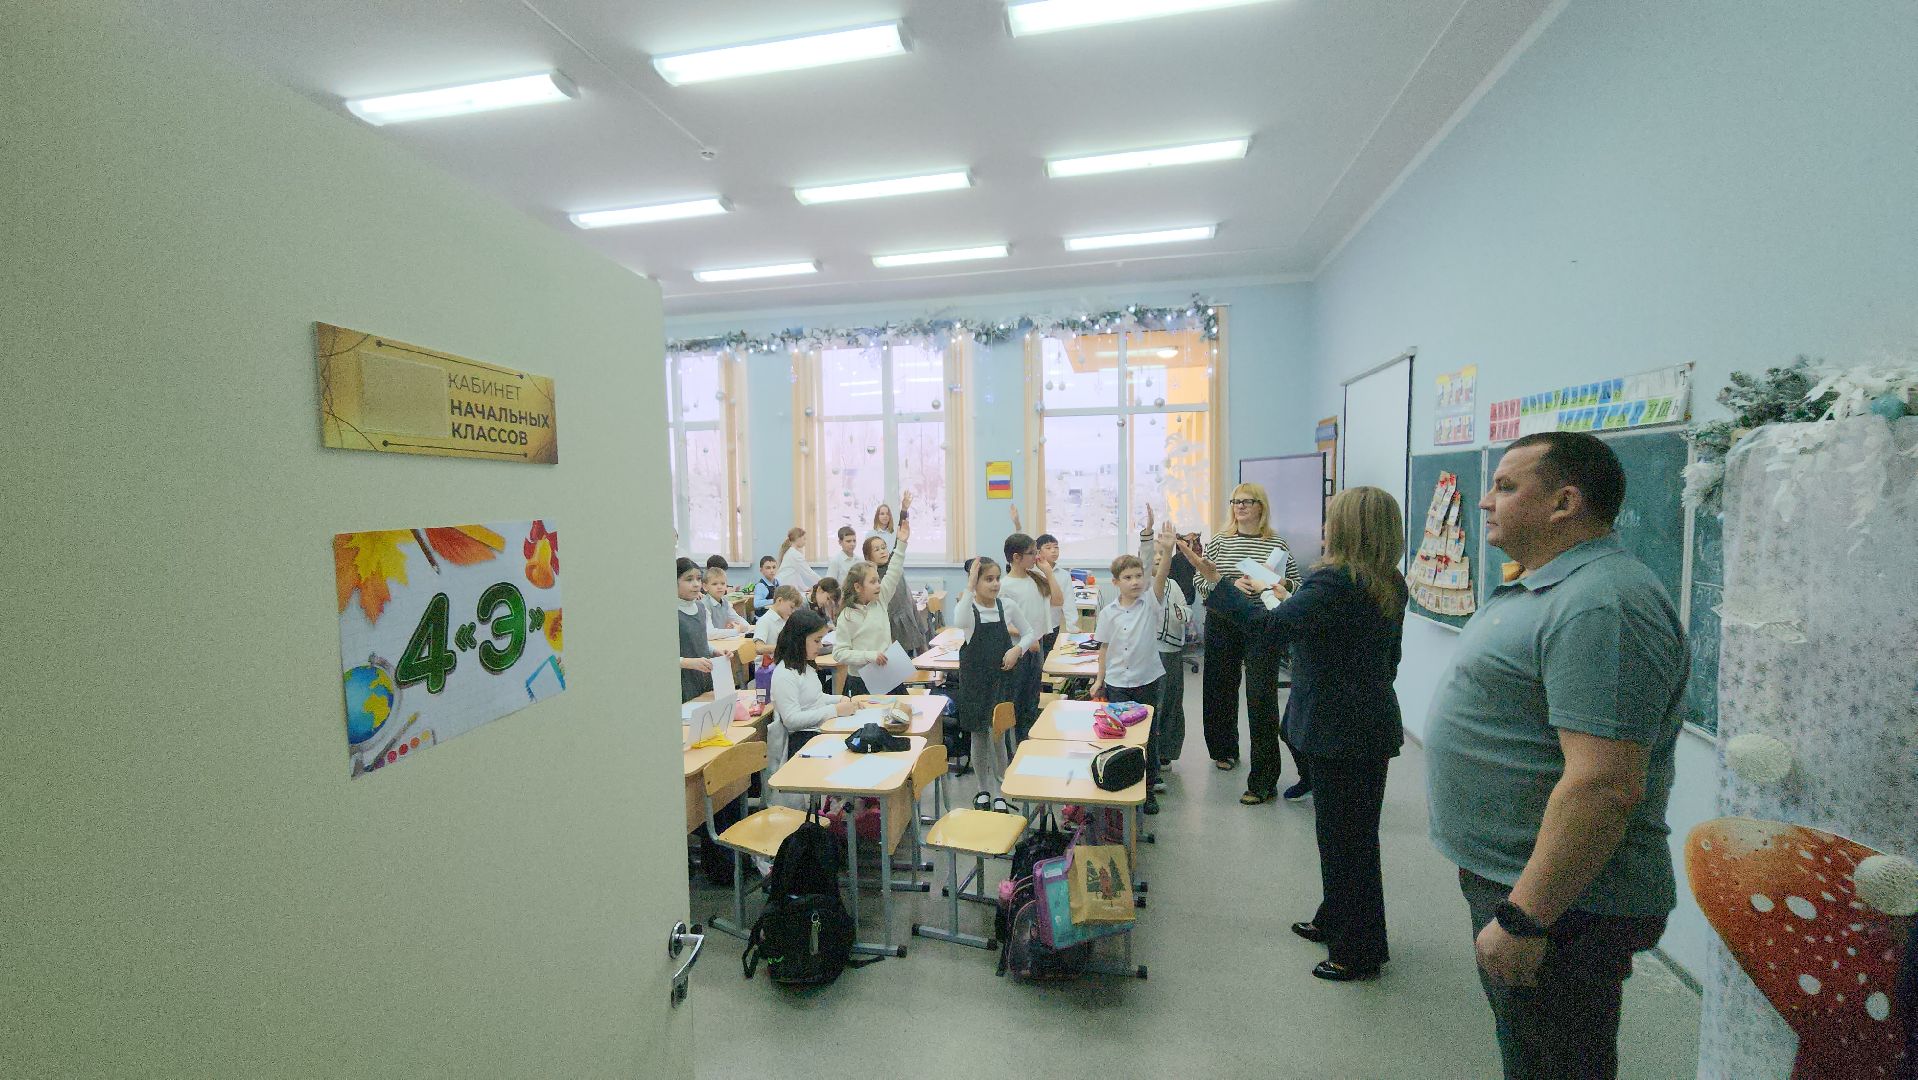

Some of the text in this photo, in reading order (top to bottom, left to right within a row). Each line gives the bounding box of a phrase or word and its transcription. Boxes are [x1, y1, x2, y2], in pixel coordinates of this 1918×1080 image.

[448, 373, 521, 400] КАБИНЕТ
[450, 399, 550, 428] НАЧАЛЬНЫХ
[451, 422, 528, 446] КЛАССОВ
